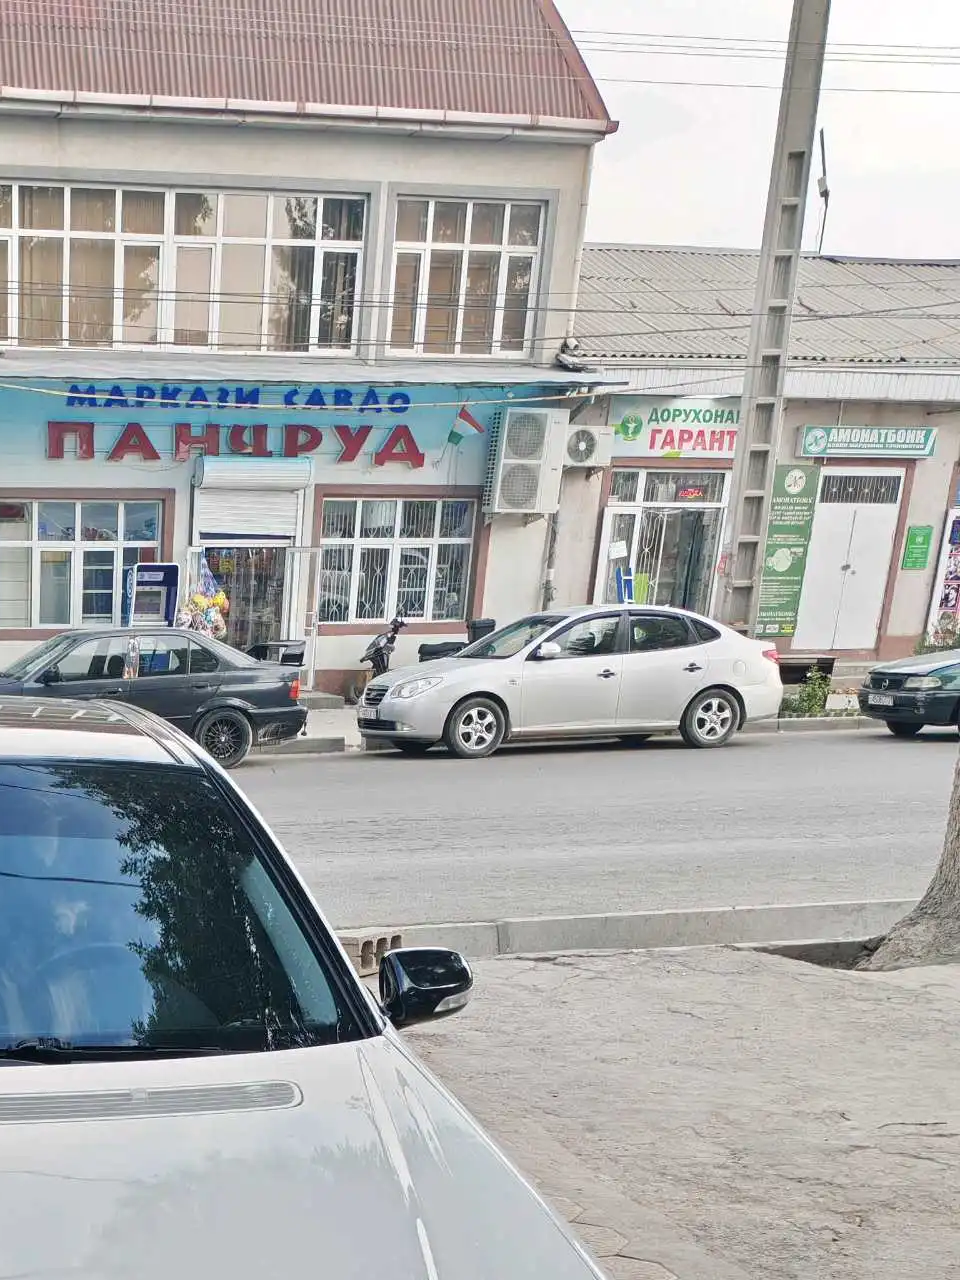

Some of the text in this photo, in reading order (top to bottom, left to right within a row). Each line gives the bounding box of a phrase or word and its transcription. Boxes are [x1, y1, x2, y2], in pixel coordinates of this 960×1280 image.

[66, 384, 411, 413] МАРКАЗИ САВДО
[648, 408, 739, 424] ДОРУХОНА
[649, 428, 738, 451] ГАРАНТ
[828, 428, 926, 443] АМОНАТБОНК
